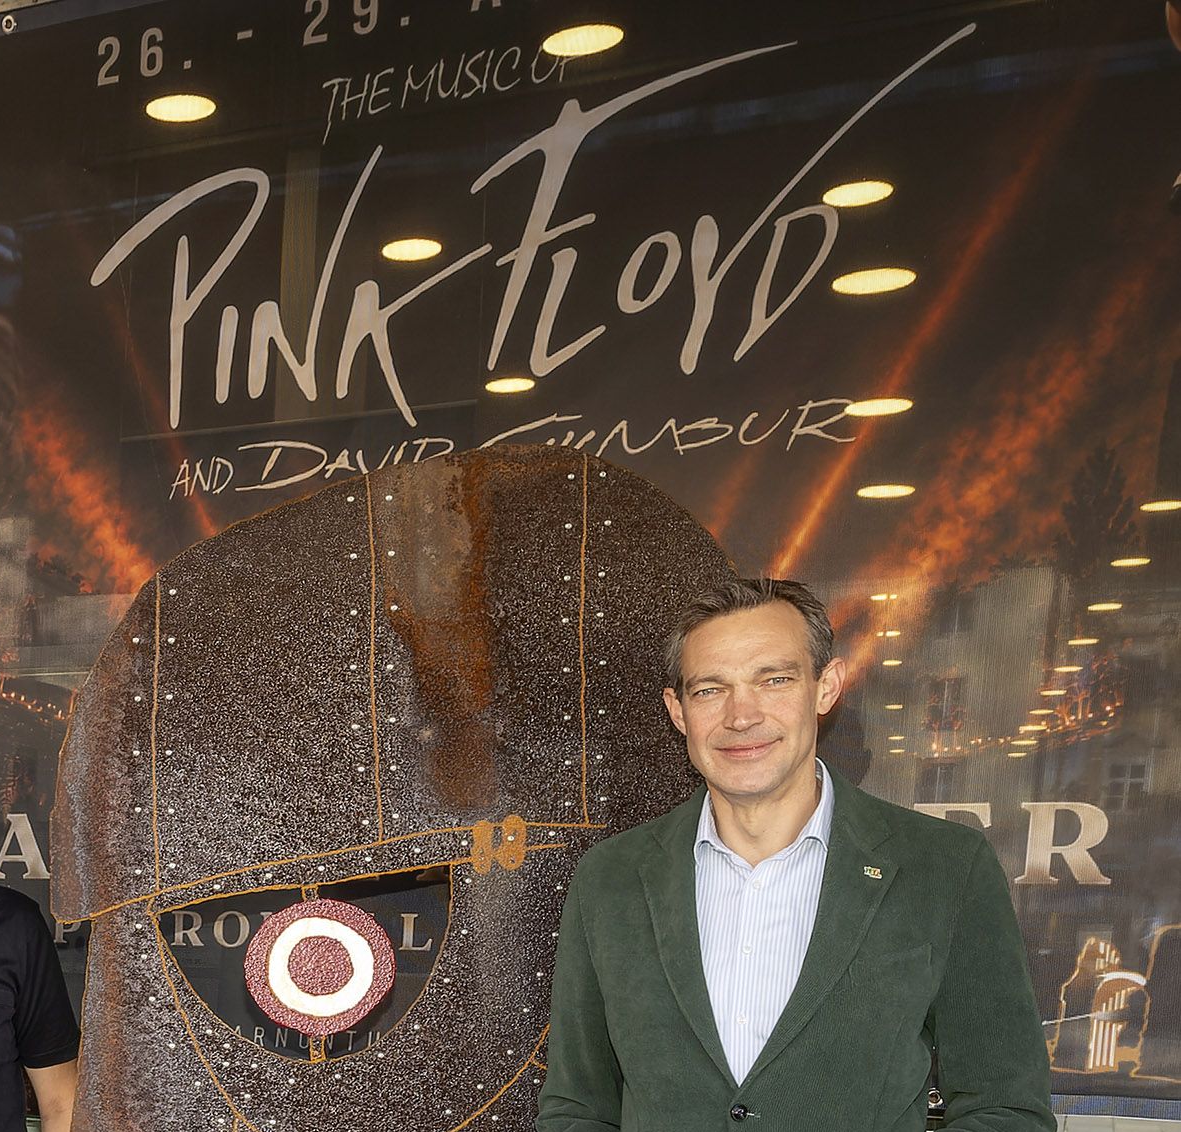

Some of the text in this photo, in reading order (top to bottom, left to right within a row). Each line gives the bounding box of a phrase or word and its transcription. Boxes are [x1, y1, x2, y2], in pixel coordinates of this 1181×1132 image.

[97, 27, 193, 87] 26.
[321, 66, 394, 145] THE
[399, 46, 521, 109] MUSIC
[90, 22, 977, 431] PINK FLOYD
[169, 459, 235, 501] AND
